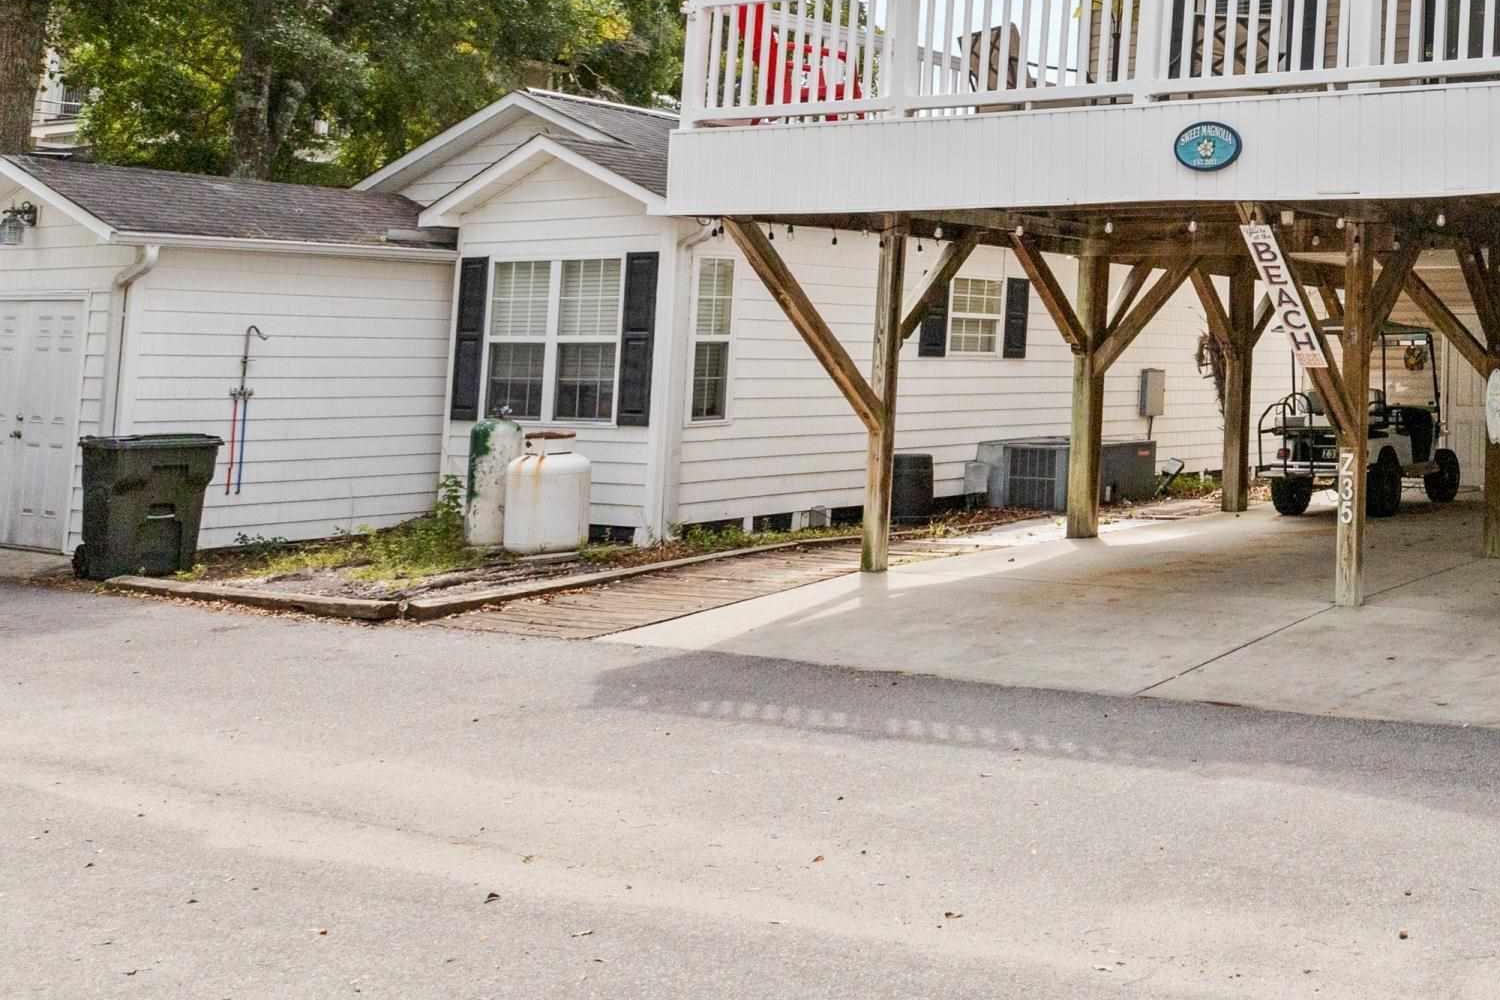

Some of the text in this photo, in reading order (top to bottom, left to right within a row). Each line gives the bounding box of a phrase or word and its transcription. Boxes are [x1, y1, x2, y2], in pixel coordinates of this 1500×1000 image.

[1179, 124, 1232, 146] SWEET MAGNOLIA
[1252, 242, 1315, 351] BEACH
[1341, 452, 1354, 524] Z35
